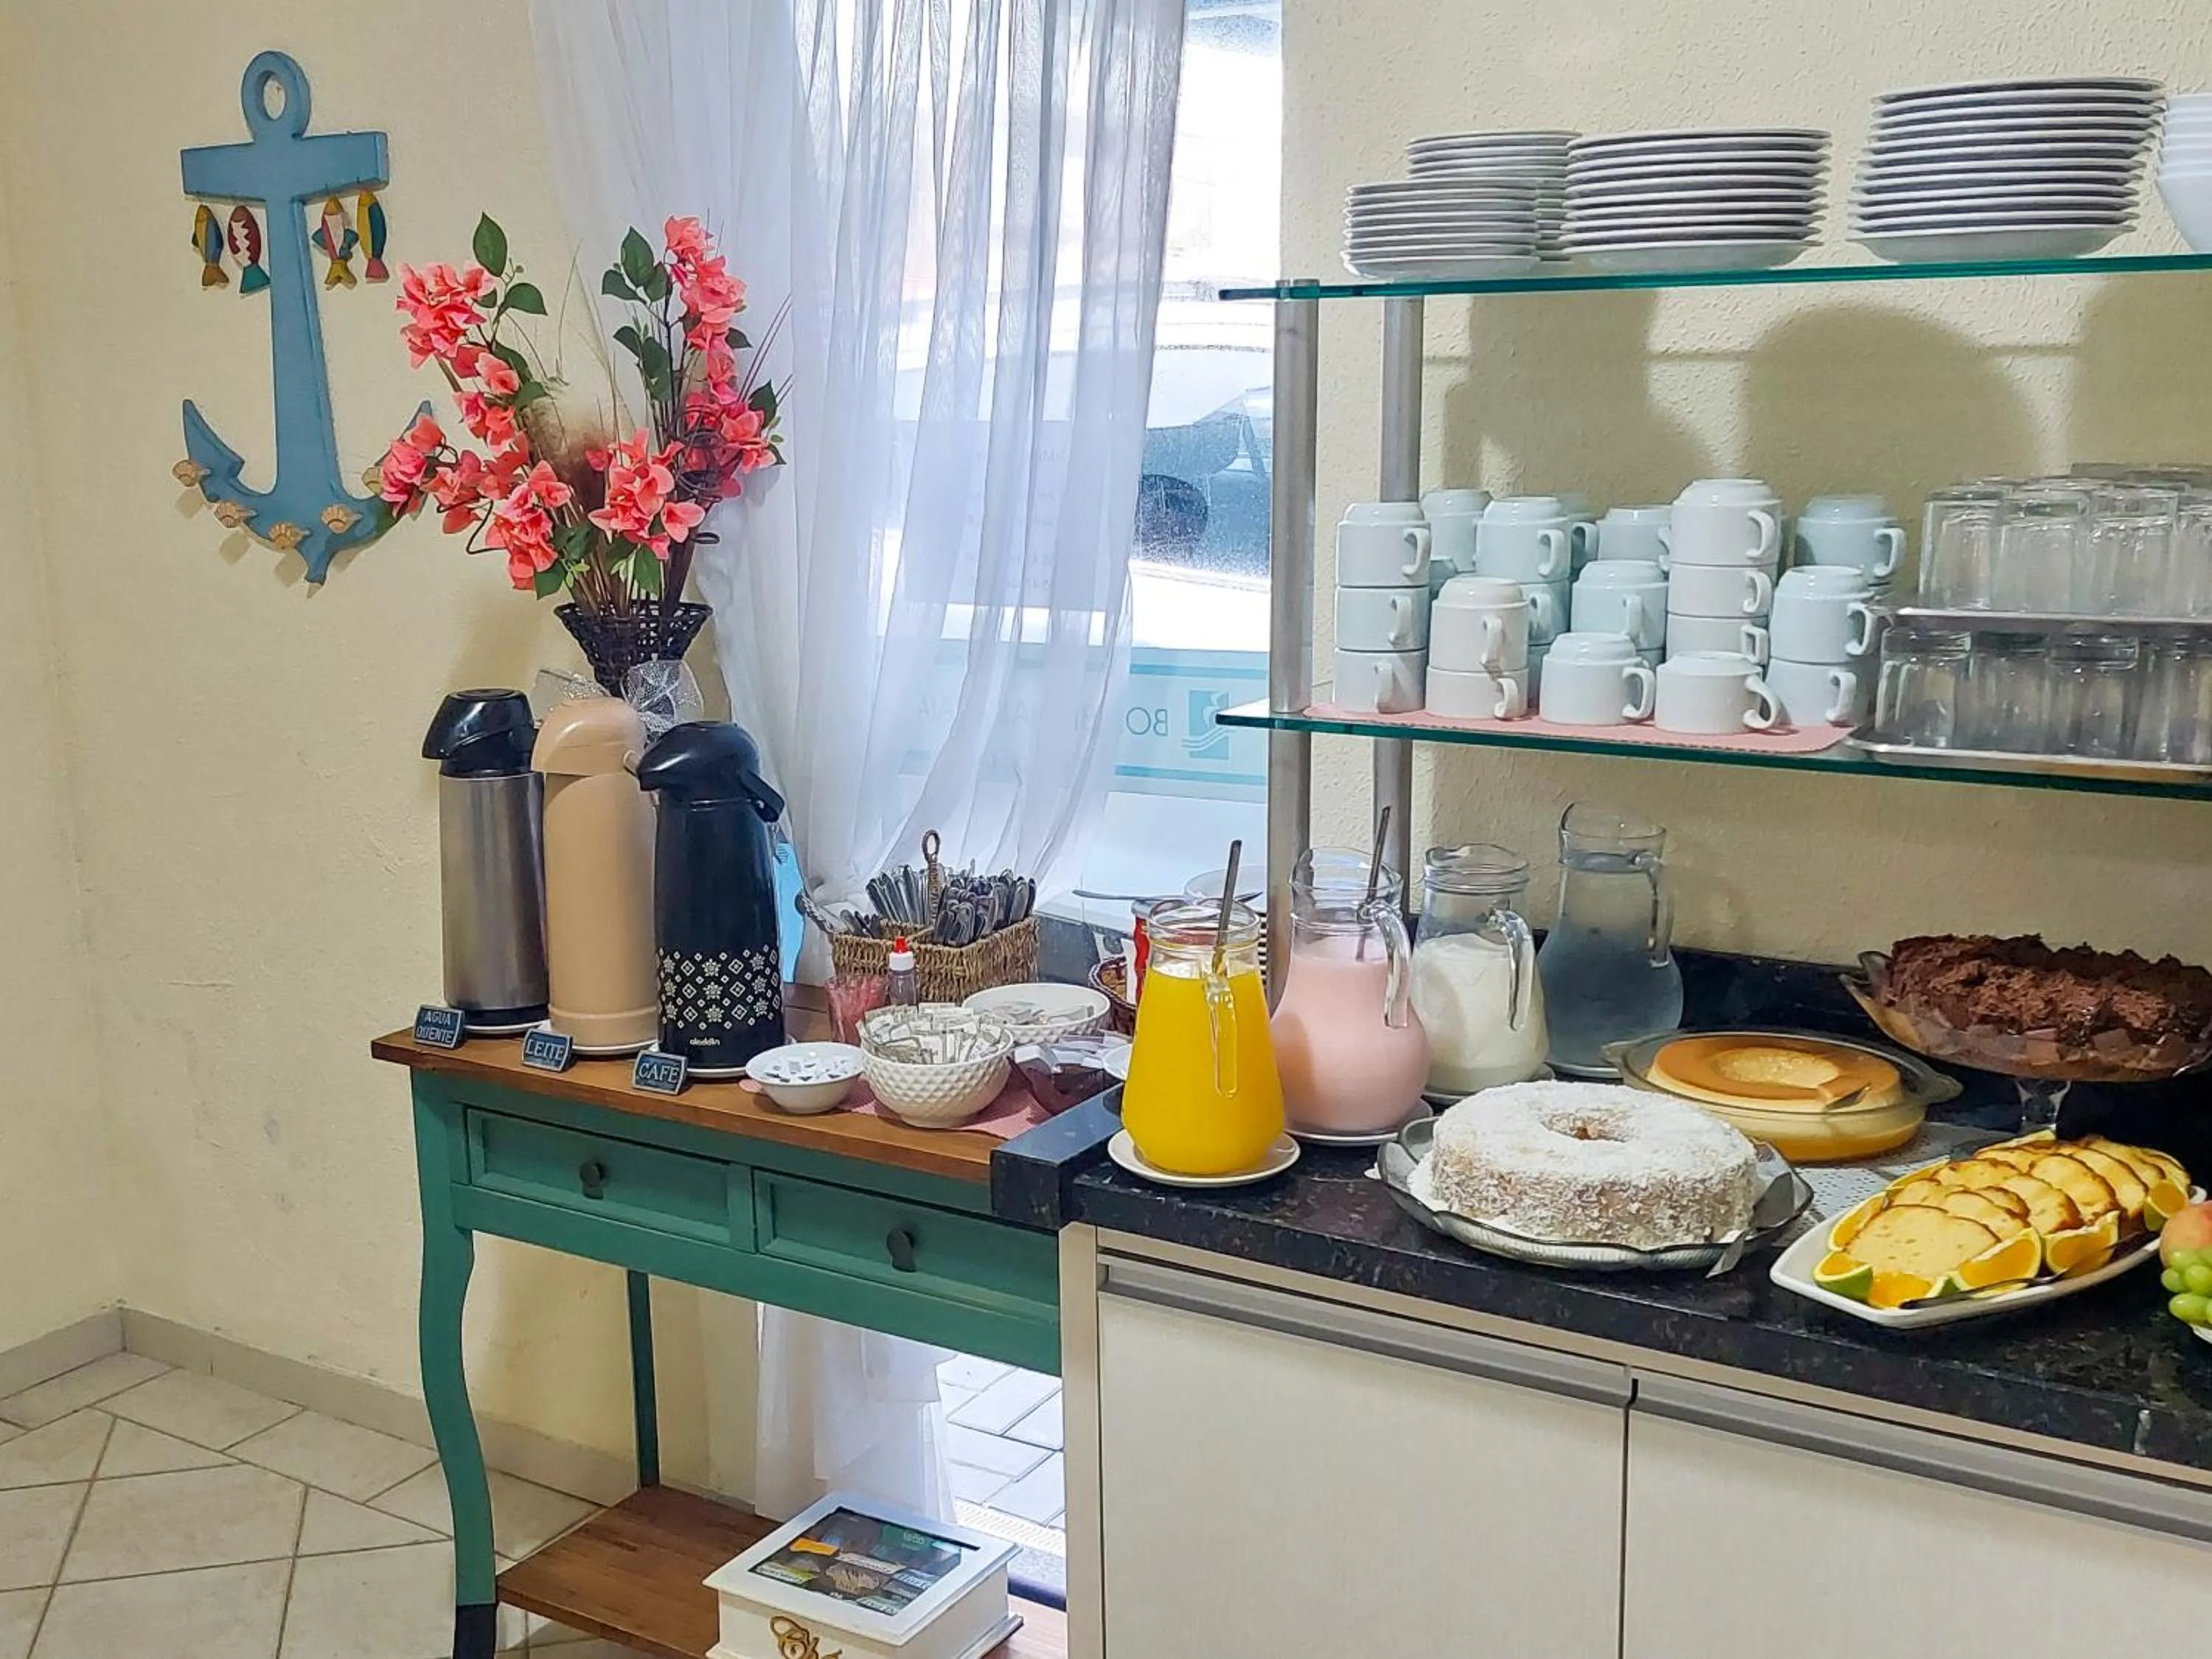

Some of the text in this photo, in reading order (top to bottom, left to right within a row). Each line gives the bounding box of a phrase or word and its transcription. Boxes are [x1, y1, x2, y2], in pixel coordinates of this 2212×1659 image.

[424, 1010, 451, 1026] AGUA
[416, 1026, 454, 1043] QUENTE
[525, 1039, 566, 1061] LEITE
